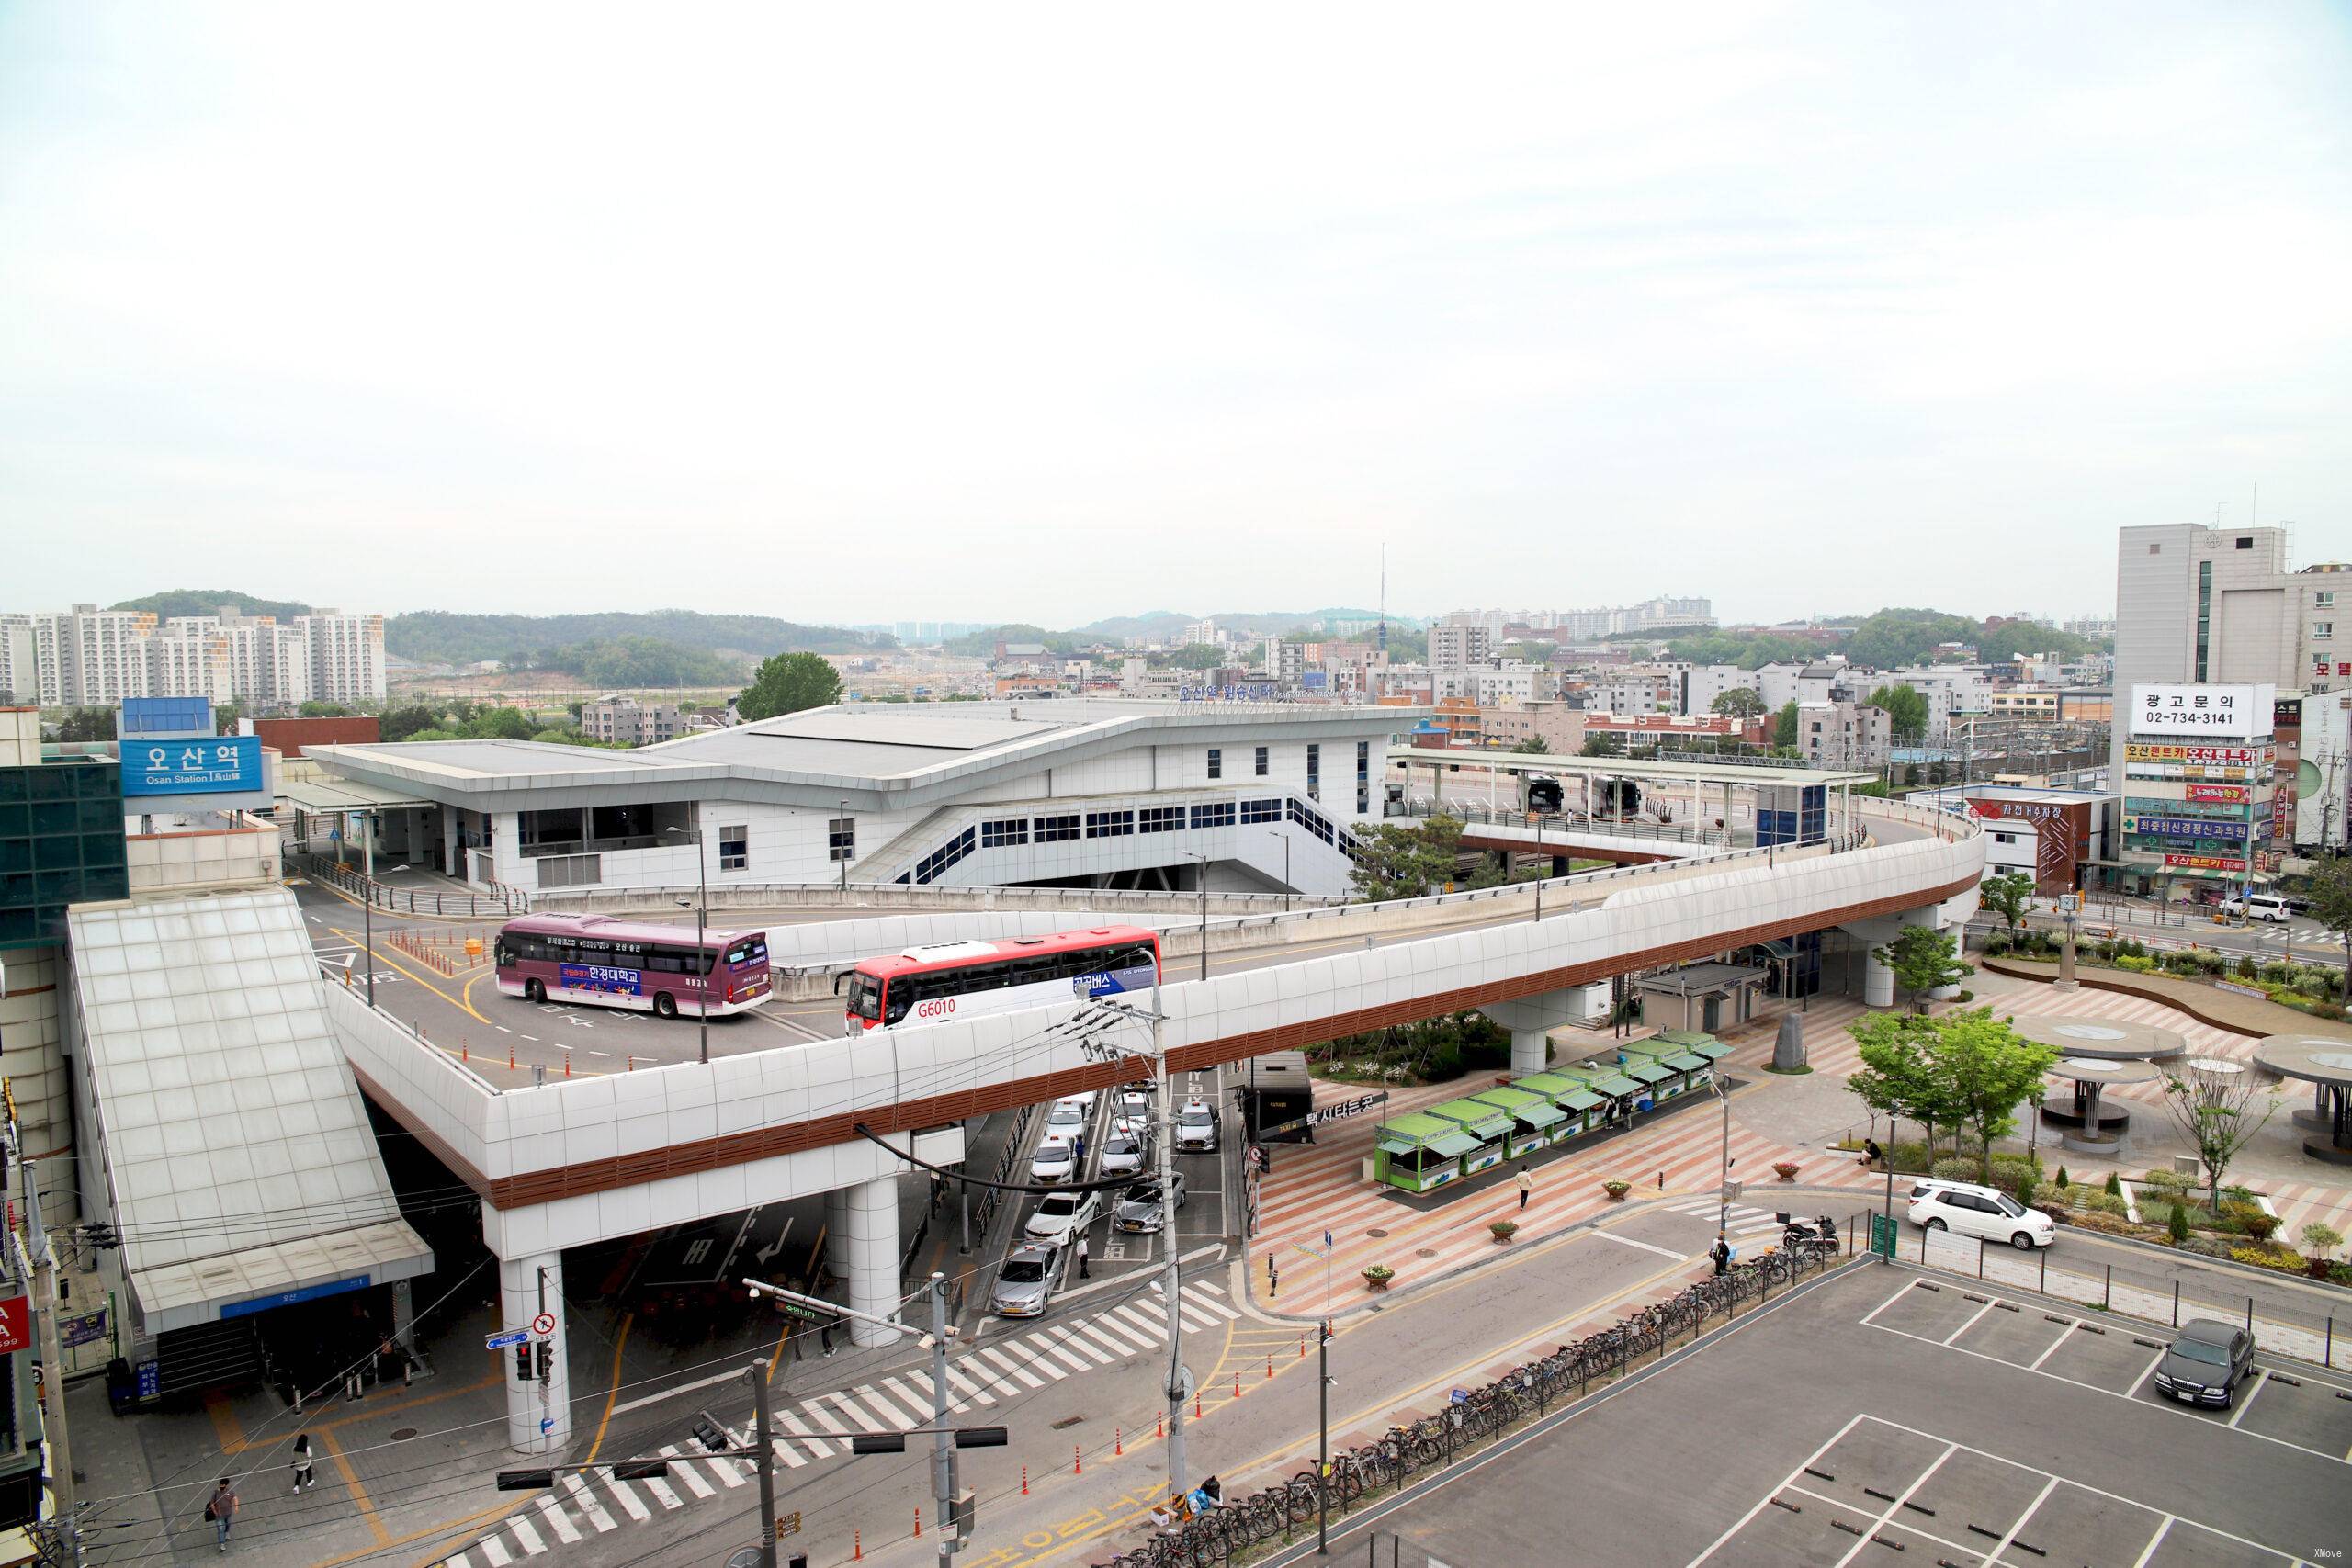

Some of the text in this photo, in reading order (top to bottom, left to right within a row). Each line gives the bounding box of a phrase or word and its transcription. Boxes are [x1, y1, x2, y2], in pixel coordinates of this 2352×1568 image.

[1180, 684, 1217, 702] 오산역
[2146, 712, 2233, 724] 02-734-3141
[146, 745, 239, 771] 오산역
[146, 773, 208, 784] Osan Station
[2003, 804, 2062, 818] 자전거주차장
[589, 966, 639, 983] 한경대학교
[918, 998, 956, 1018] G6010
[1278, 1123, 1292, 1133] TAXI
[283, 1293, 298, 1302] 오산
